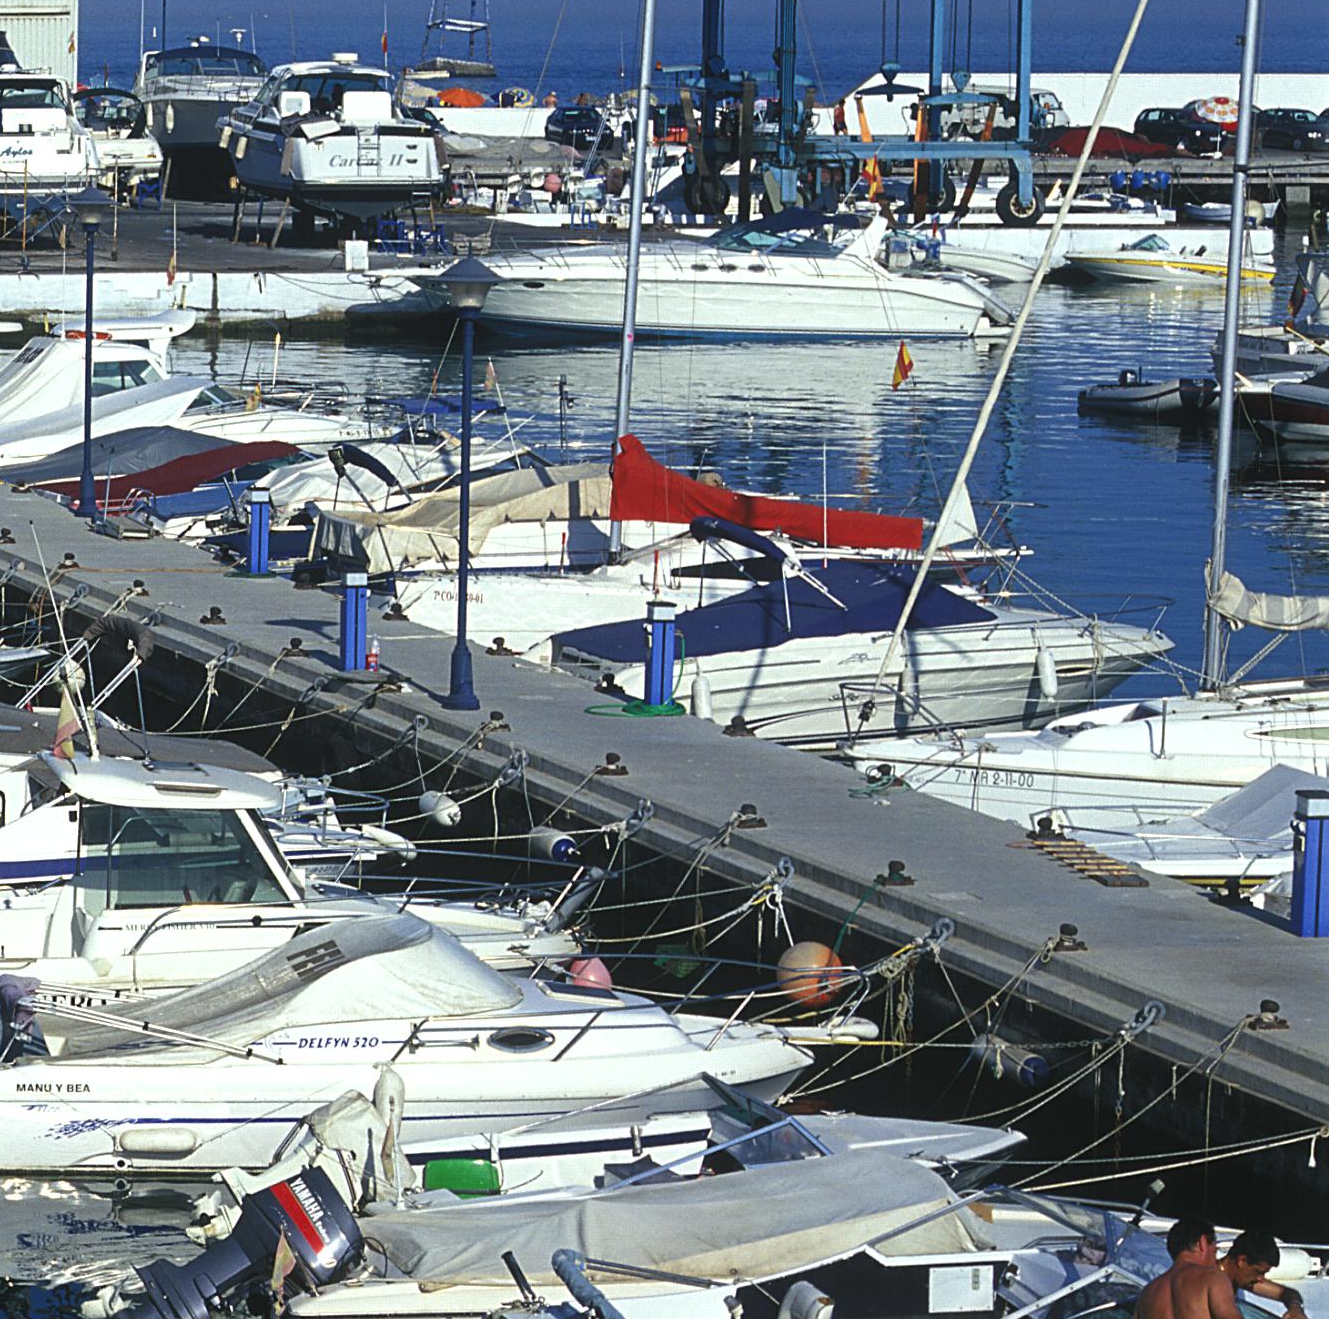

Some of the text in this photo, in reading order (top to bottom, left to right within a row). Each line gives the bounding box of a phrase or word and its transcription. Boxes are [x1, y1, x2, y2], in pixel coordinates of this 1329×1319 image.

[298, 1037, 379, 1048] DELFYN 520
[16, 1083, 91, 1093] MANU Y BEA
[290, 1177, 324, 1224] YAMAHA
